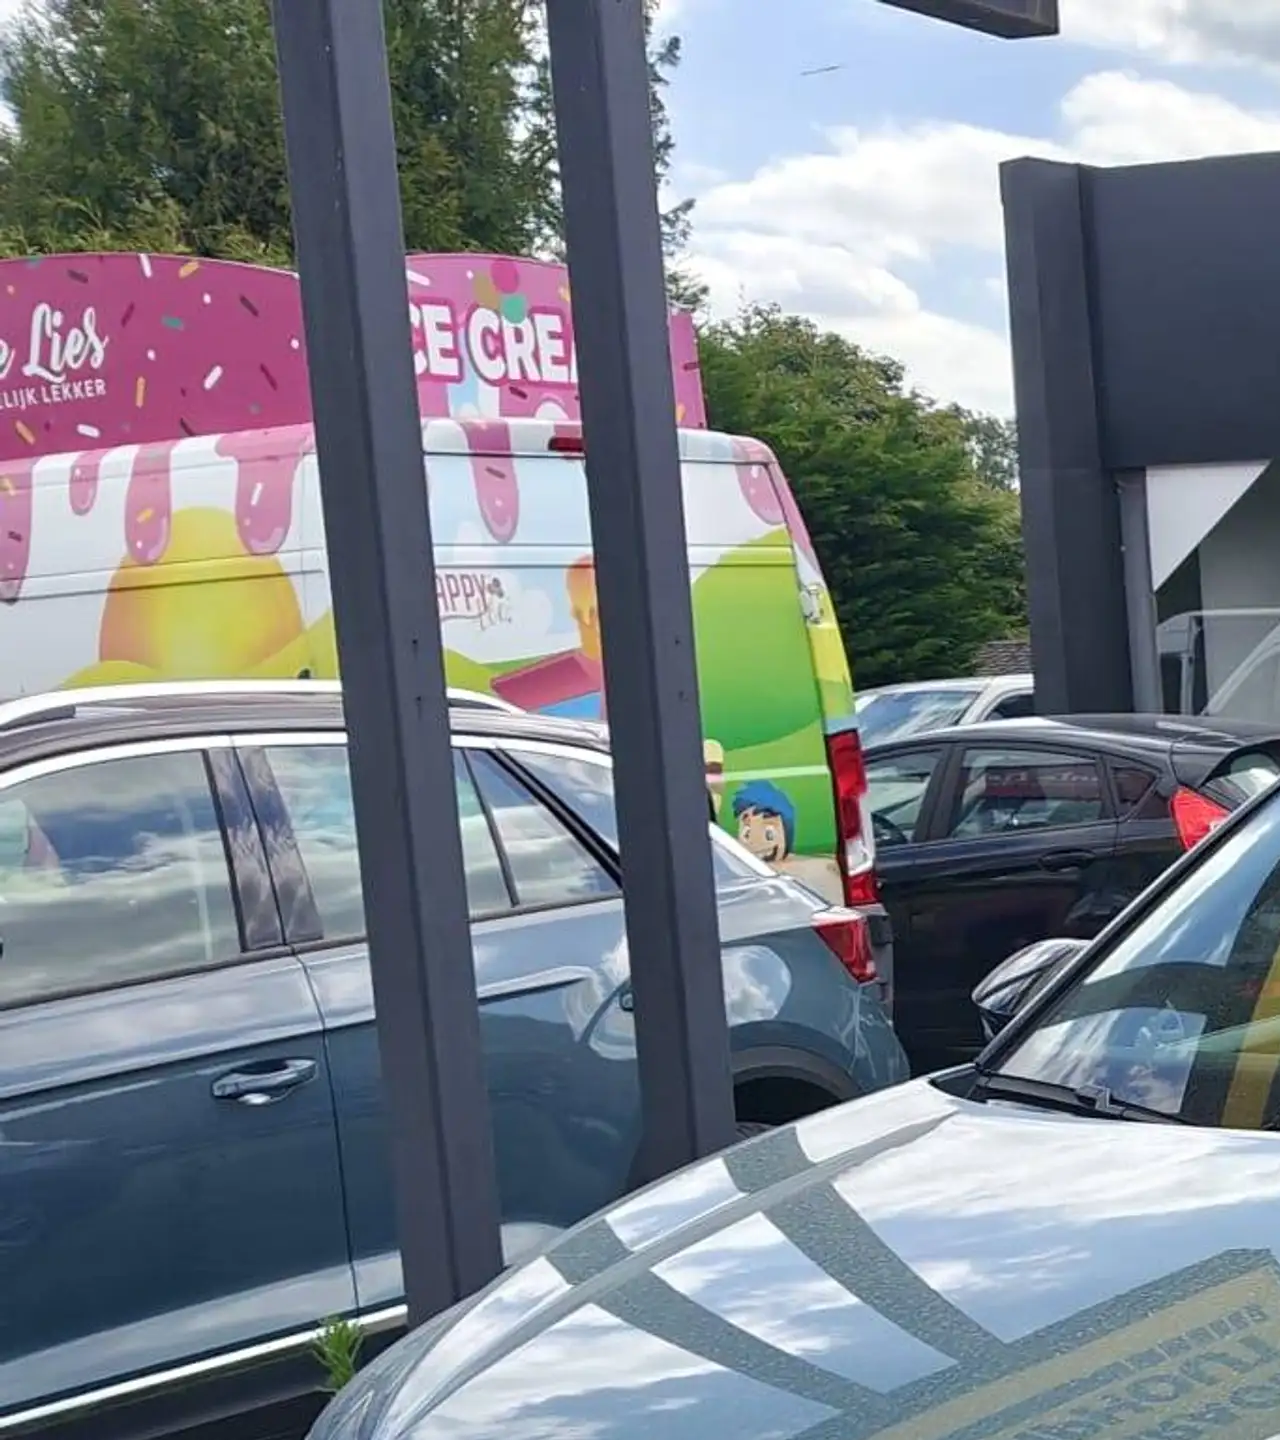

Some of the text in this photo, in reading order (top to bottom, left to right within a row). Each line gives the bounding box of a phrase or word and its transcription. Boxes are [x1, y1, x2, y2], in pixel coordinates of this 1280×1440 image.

[21, 302, 110, 383] Lies
[468, 308, 578, 382] CRE
[41, 378, 107, 405] LEKKER
[435, 572, 489, 612] APPY
